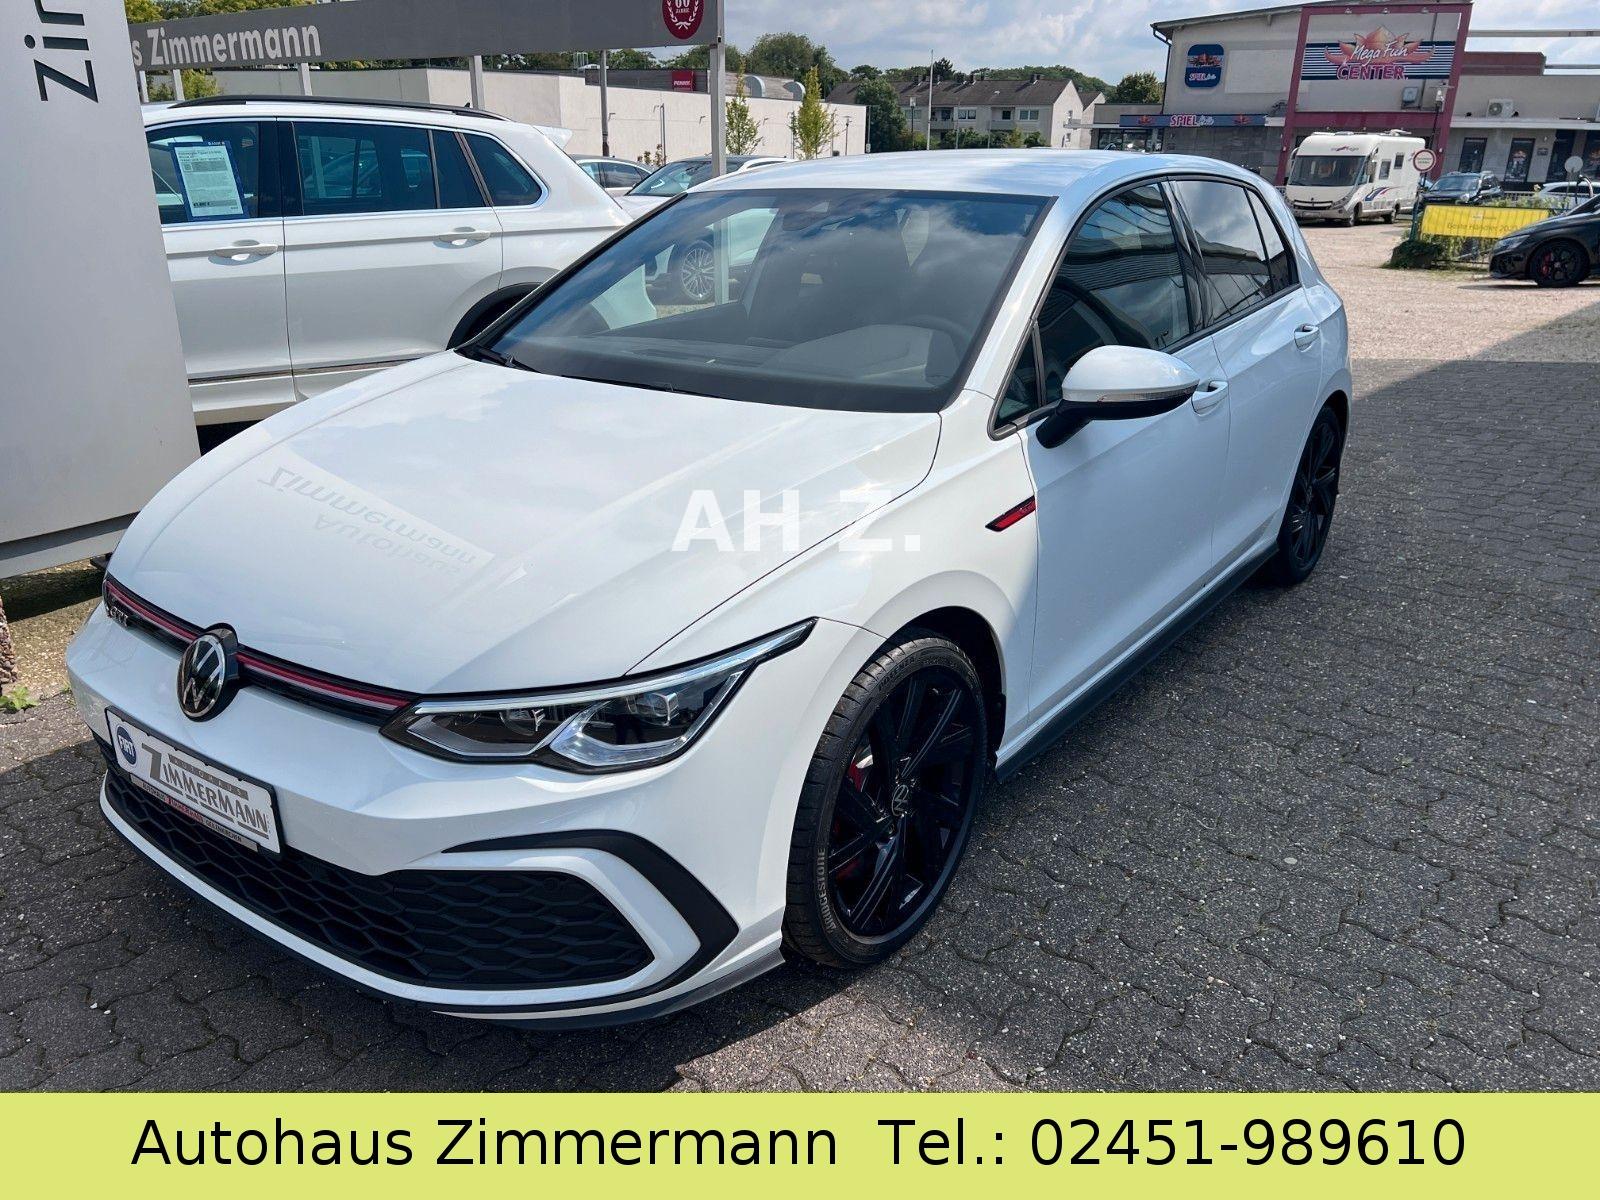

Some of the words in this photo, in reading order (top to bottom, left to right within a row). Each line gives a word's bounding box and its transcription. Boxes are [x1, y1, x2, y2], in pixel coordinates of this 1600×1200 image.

[146, 25, 322, 66] Zimmermann
[1350, 44, 1381, 67] Mega
[1382, 41, 1409, 58] Fun
